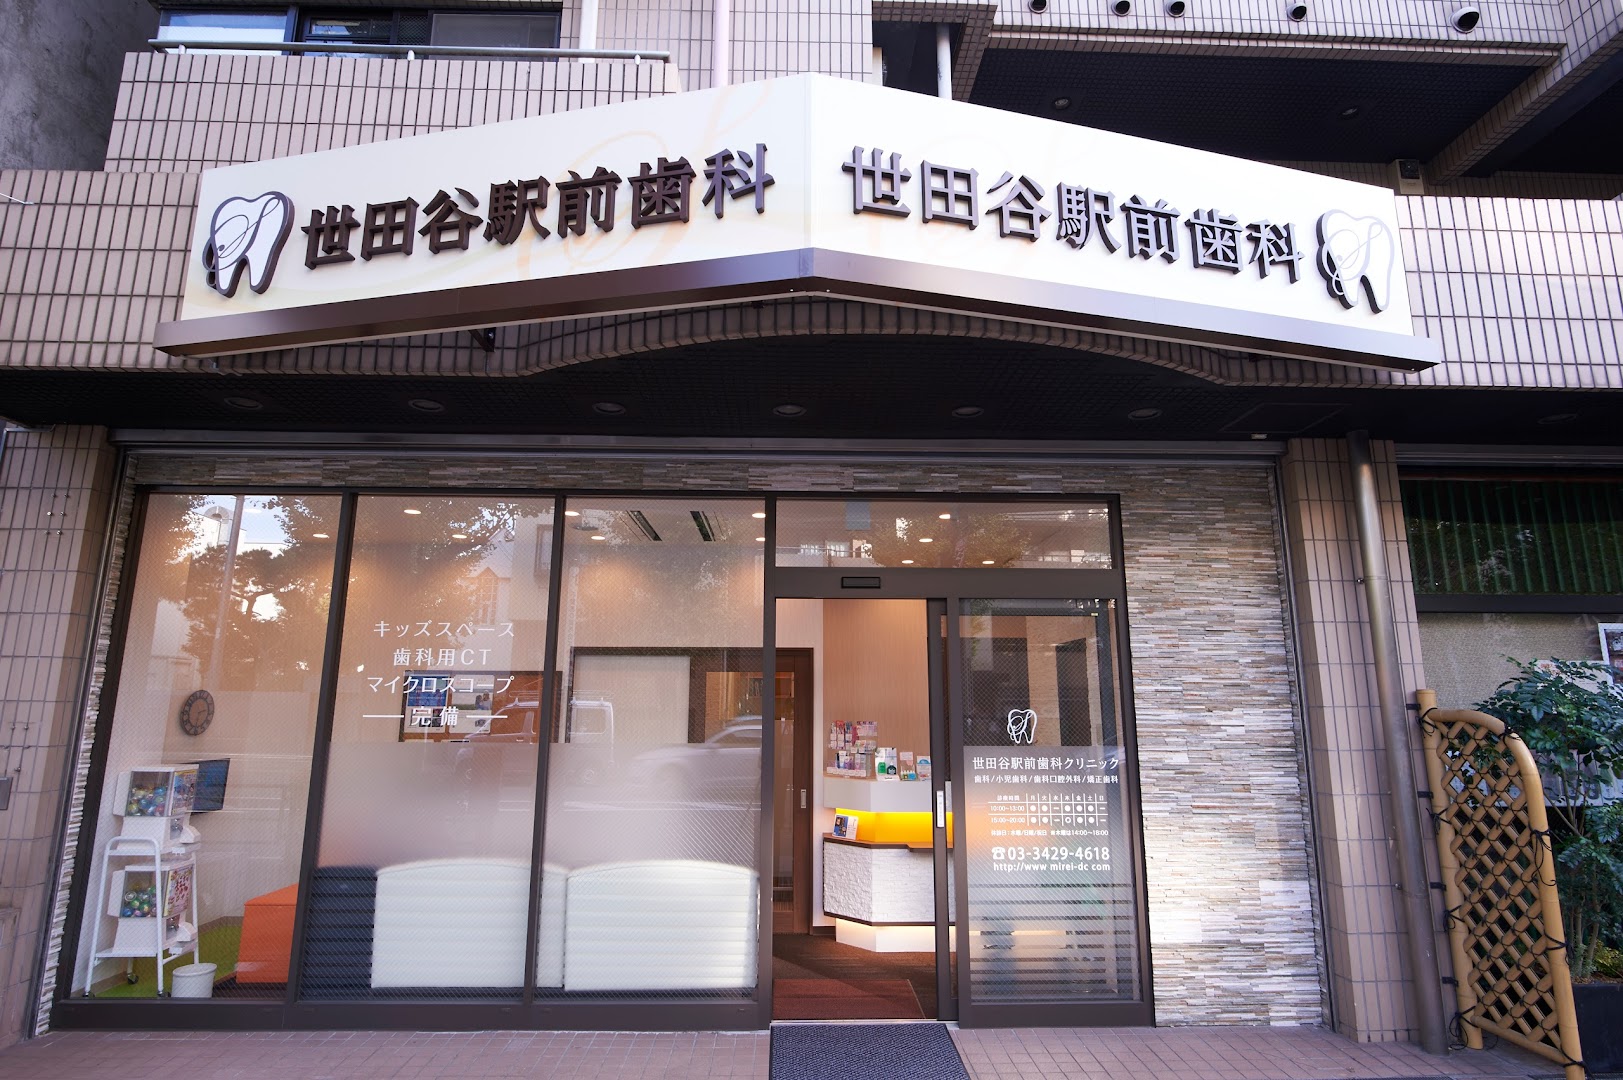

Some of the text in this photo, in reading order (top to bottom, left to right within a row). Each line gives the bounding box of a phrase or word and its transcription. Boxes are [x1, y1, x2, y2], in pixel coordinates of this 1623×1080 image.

[301, 143, 775, 270] 世田谷駅前歯科
[842, 146, 1305, 284] 世田谷駅前歯科
[373, 620, 515, 638] キッズスペース
[393, 648, 492, 667] 歯科用CT
[367, 675, 515, 694] マイクロスコープ
[410, 705, 460, 726] 完備
[972, 756, 1120, 770] 世田谷駅前歯科クリニック
[1007, 846, 1110, 860] 03-3429-4618
